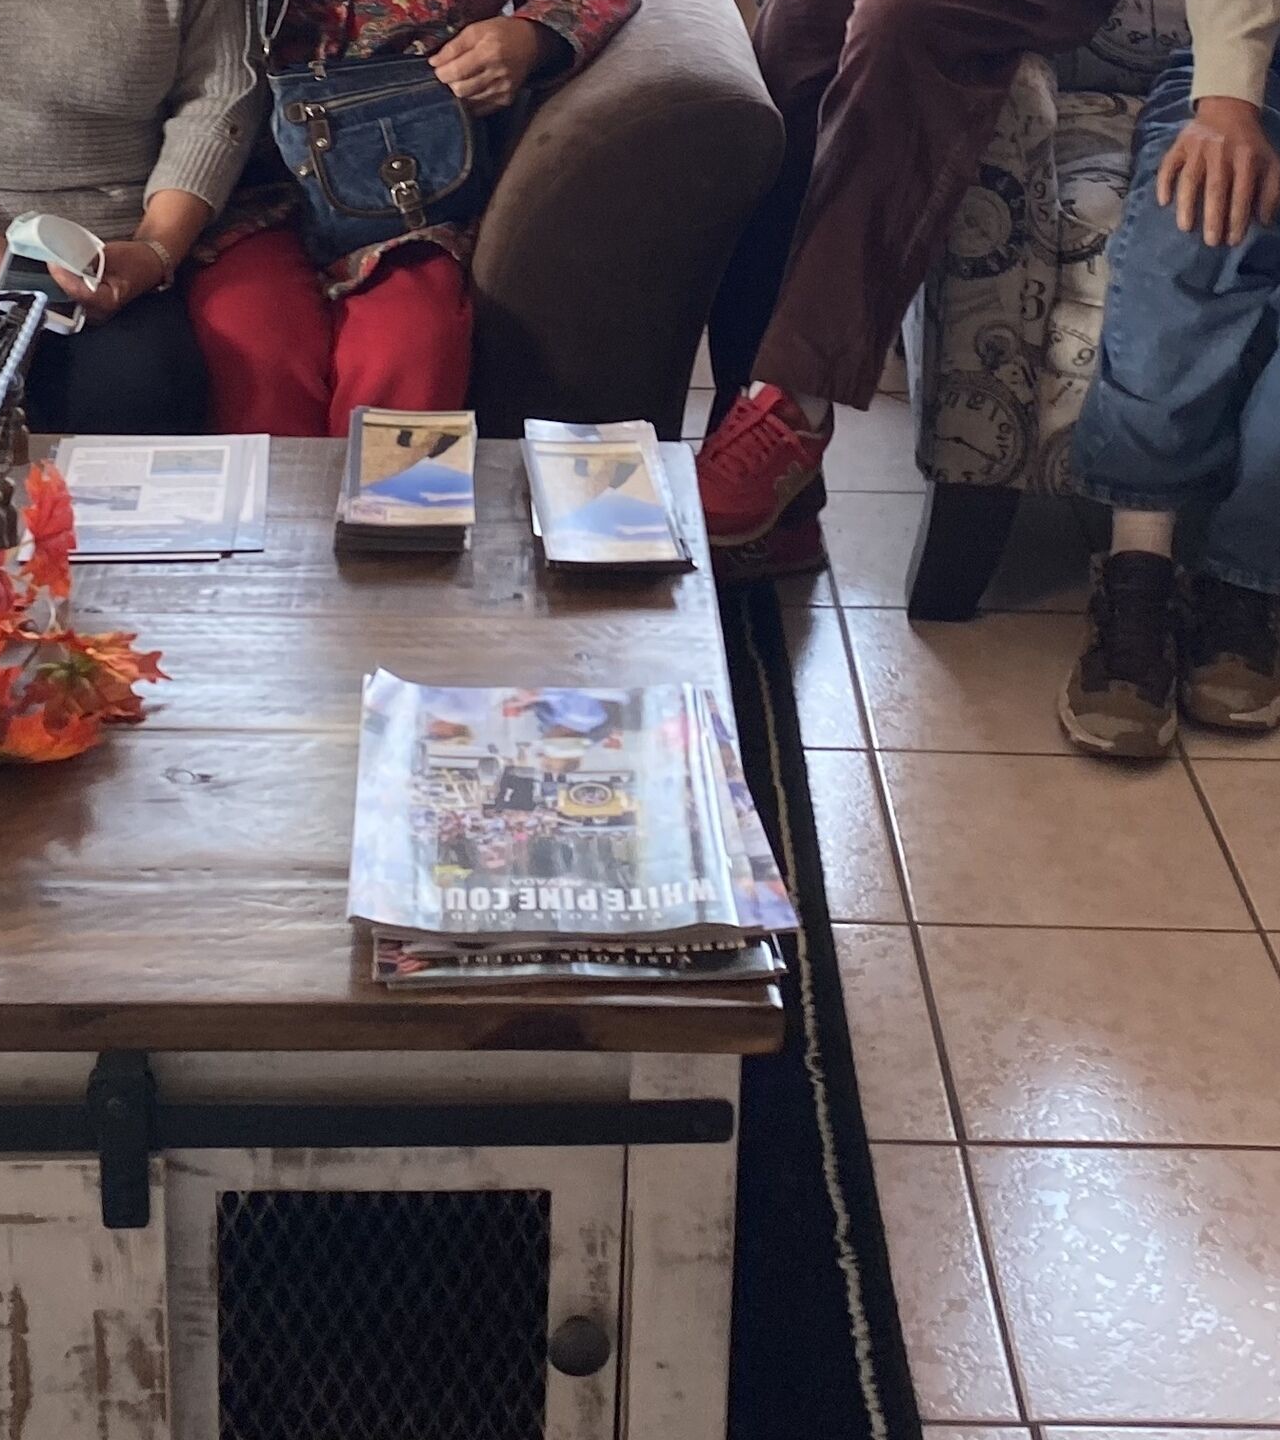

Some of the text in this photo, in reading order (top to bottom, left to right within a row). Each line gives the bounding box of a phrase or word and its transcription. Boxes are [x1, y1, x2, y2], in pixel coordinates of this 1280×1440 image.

[442, 877, 717, 911] WHITE PINE COU
